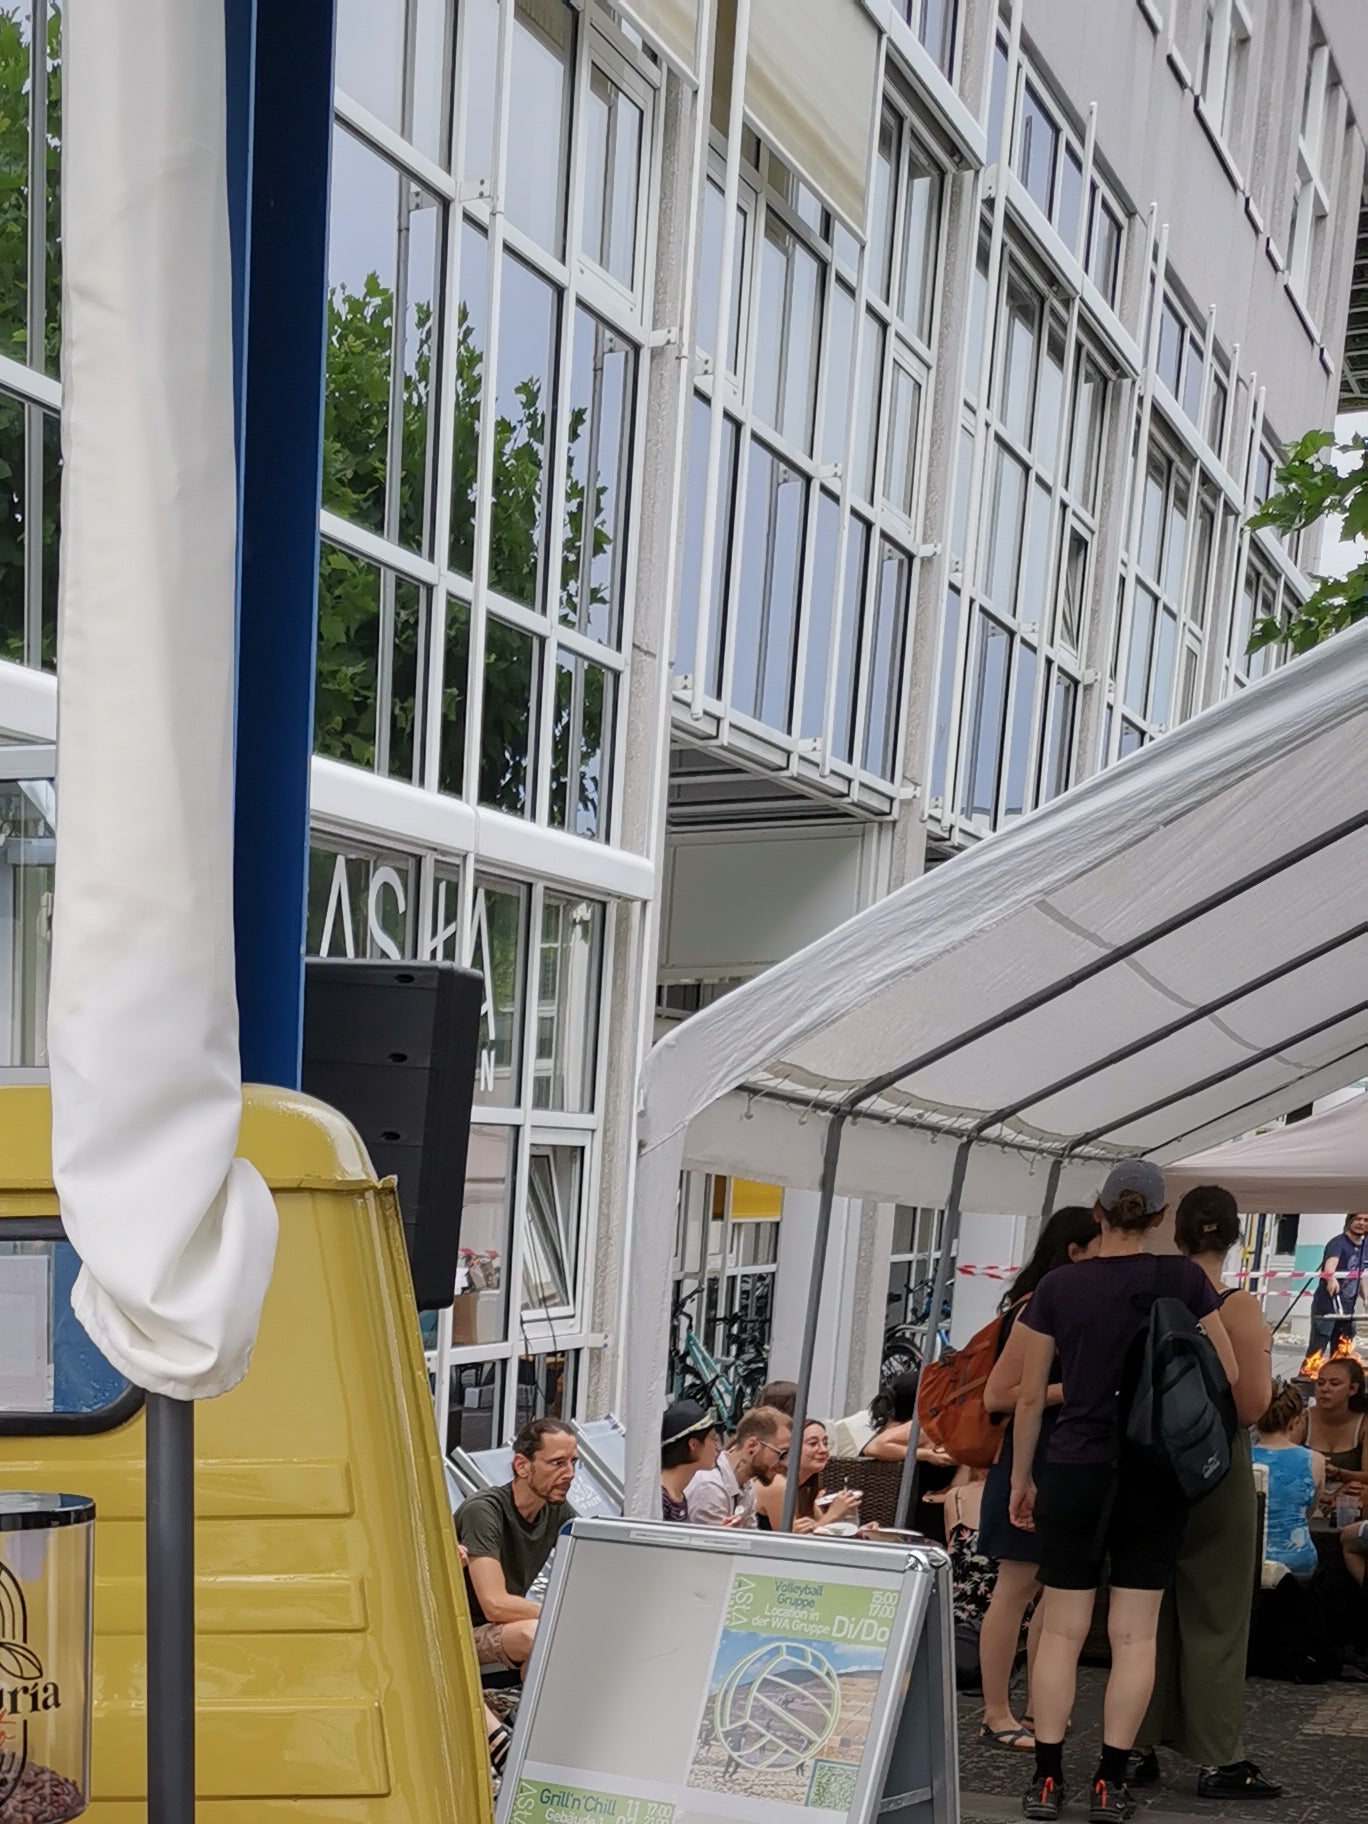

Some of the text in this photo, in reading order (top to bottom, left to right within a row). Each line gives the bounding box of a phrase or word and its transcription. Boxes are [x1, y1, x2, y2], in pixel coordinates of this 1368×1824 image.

[774, 1580, 824, 1597] Volleyball
[777, 1594, 815, 1609] Gruppe
[764, 1604, 820, 1621] Location in
[751, 1615, 831, 1636] der WA Gruppe
[832, 1616, 890, 1643] Di/Do
[627, 1799, 640, 1818] 11
